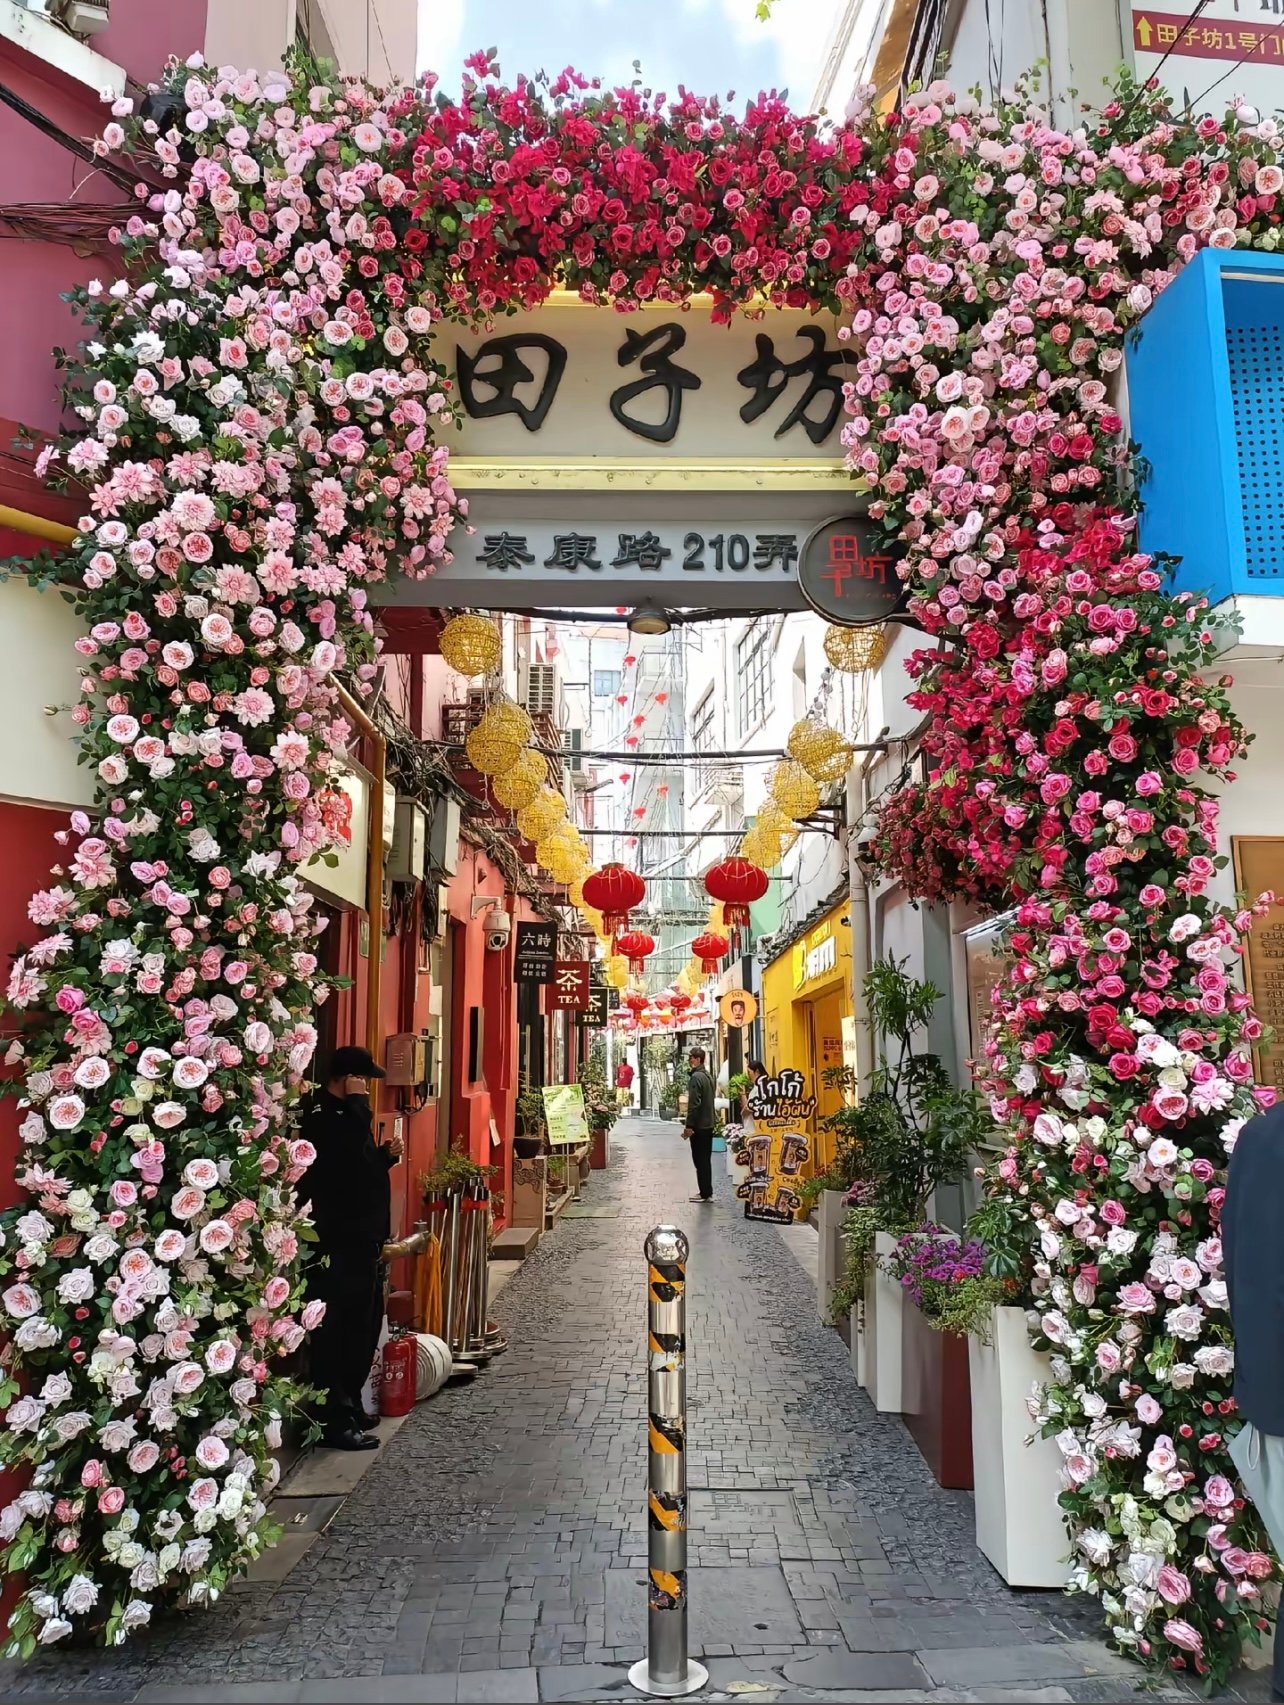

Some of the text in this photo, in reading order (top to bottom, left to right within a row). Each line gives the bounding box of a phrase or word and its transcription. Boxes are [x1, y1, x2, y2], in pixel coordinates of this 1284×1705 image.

[1157, 23, 1284, 55] 田子坊1号门
[456, 322, 859, 445] 田子坊
[476, 531, 798, 573] 泰康路210弄
[557, 995, 581, 1004] TEA
